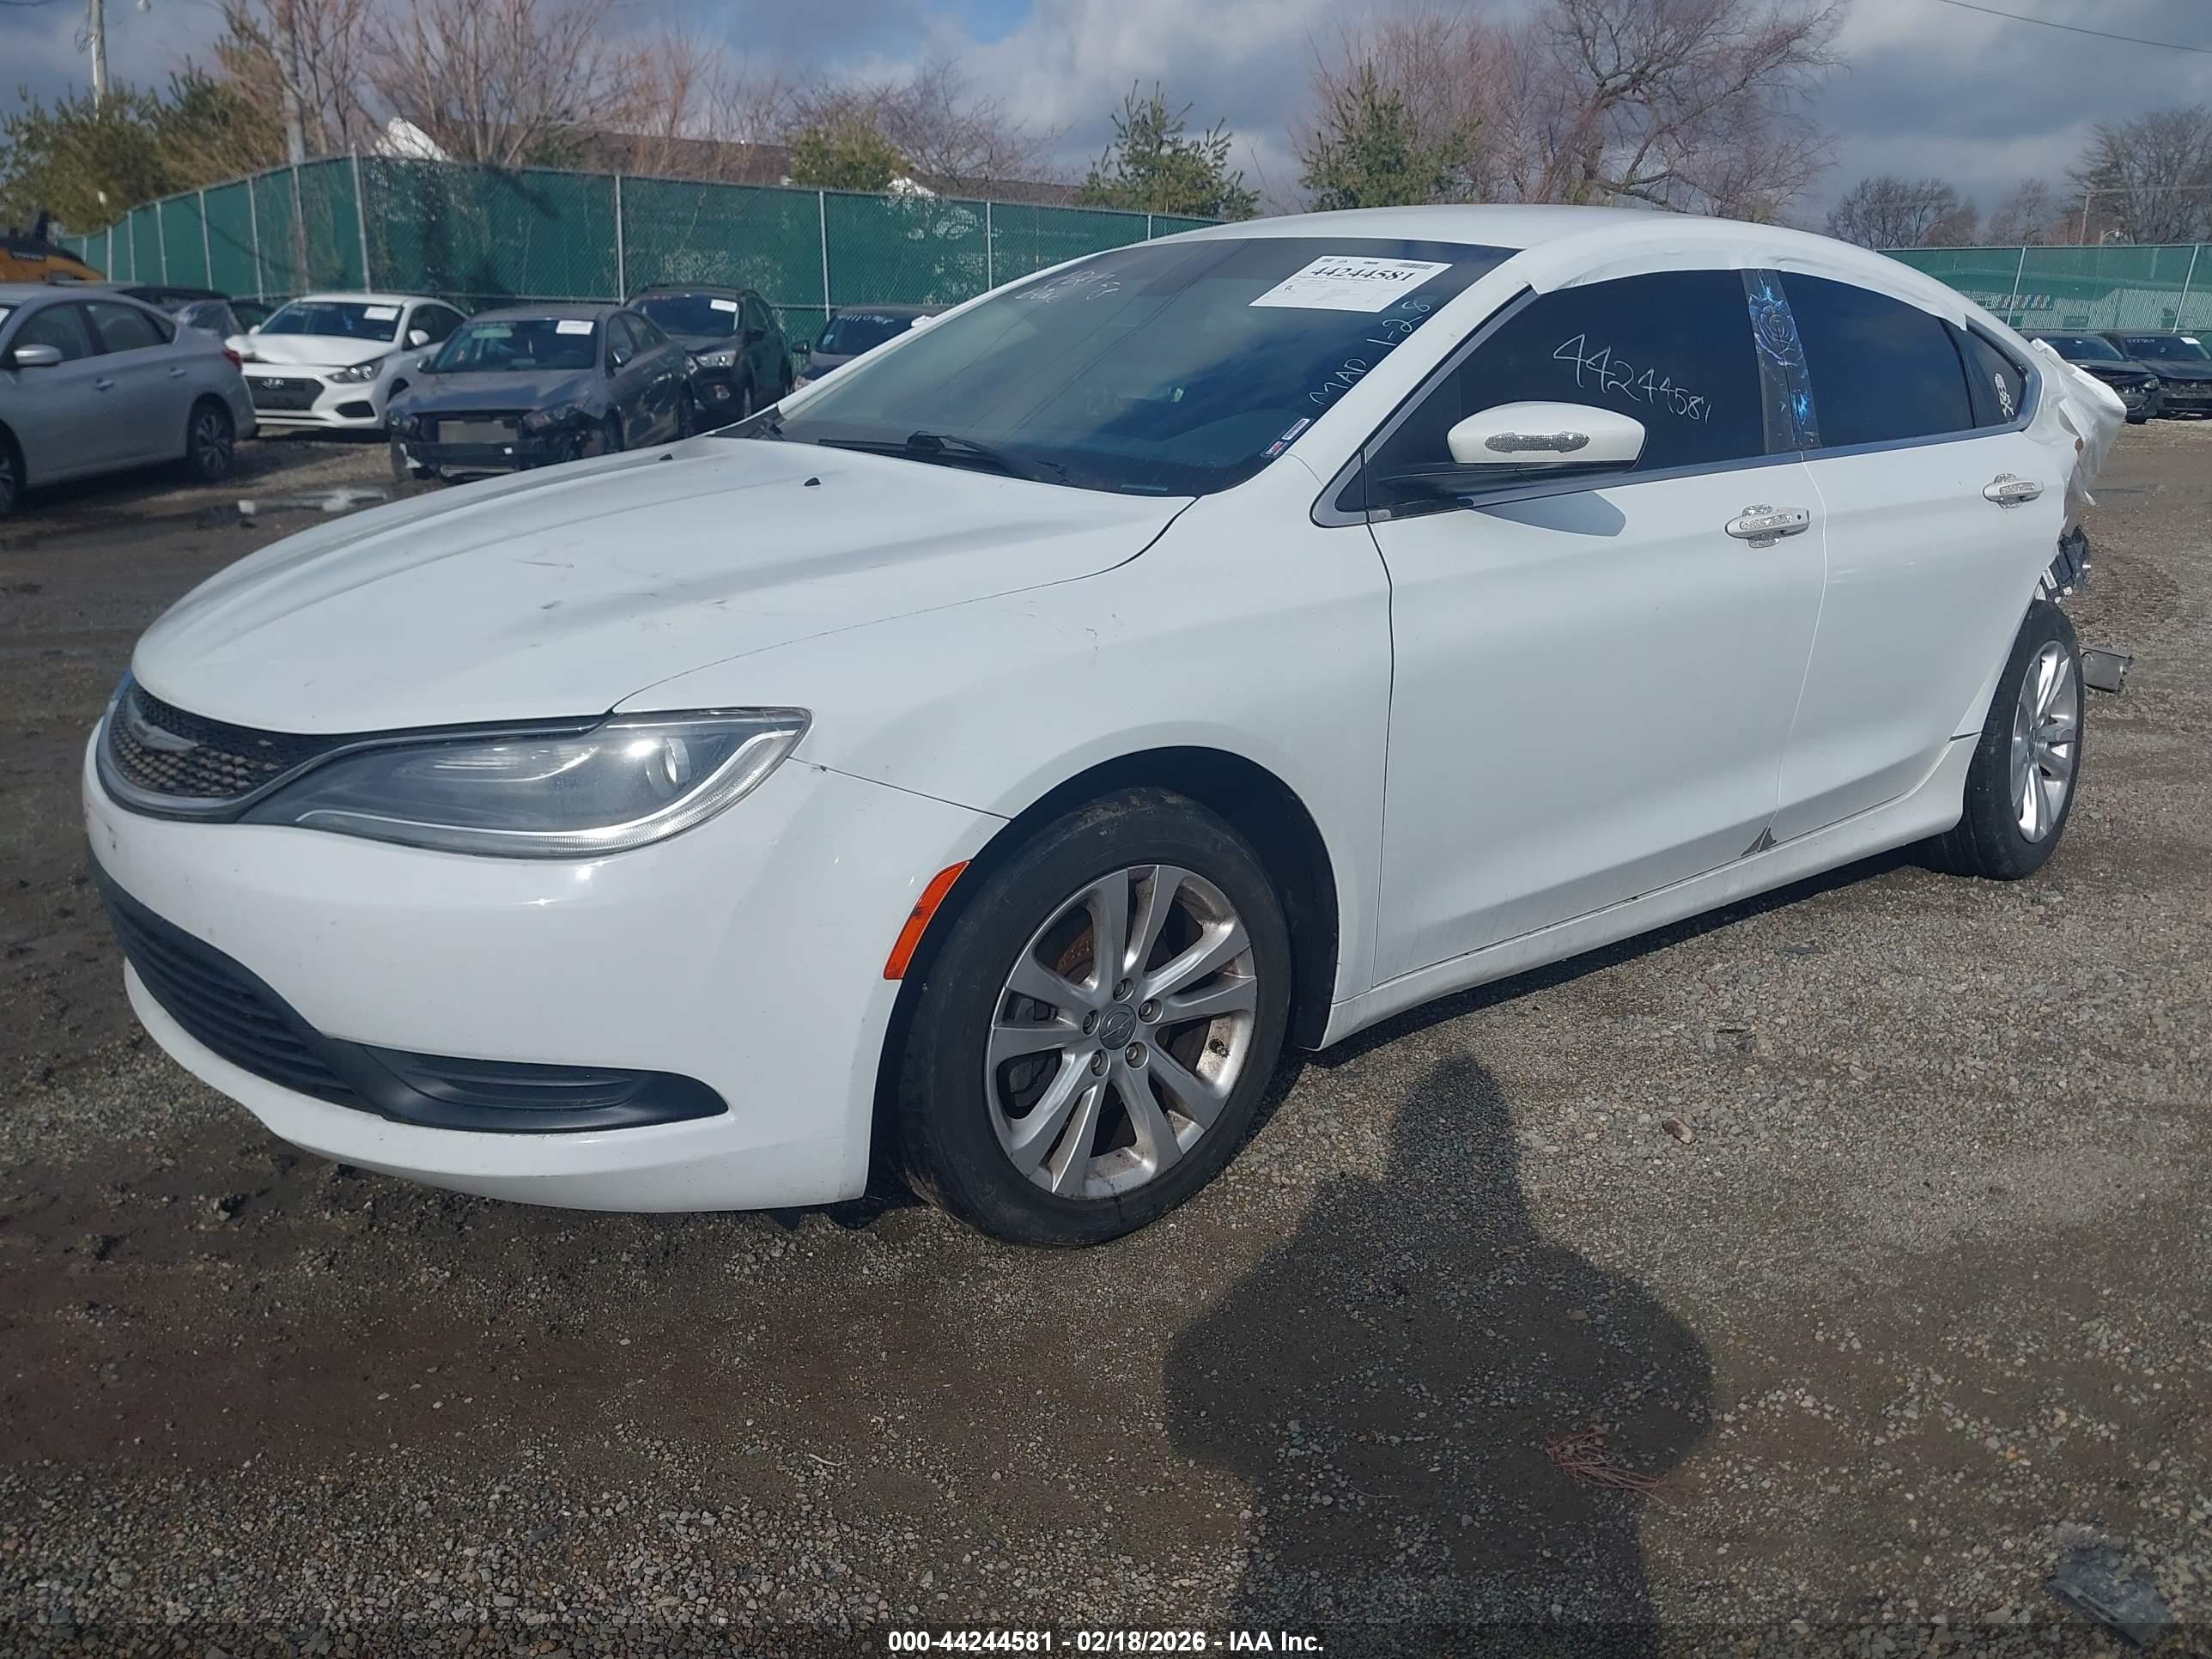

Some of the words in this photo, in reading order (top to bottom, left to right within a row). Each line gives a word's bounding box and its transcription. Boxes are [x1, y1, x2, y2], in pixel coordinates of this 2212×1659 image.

[1310, 266, 1416, 282] 44244581
[1309, 358, 1367, 406] MAD
[1553, 333, 1712, 424] 44244581
